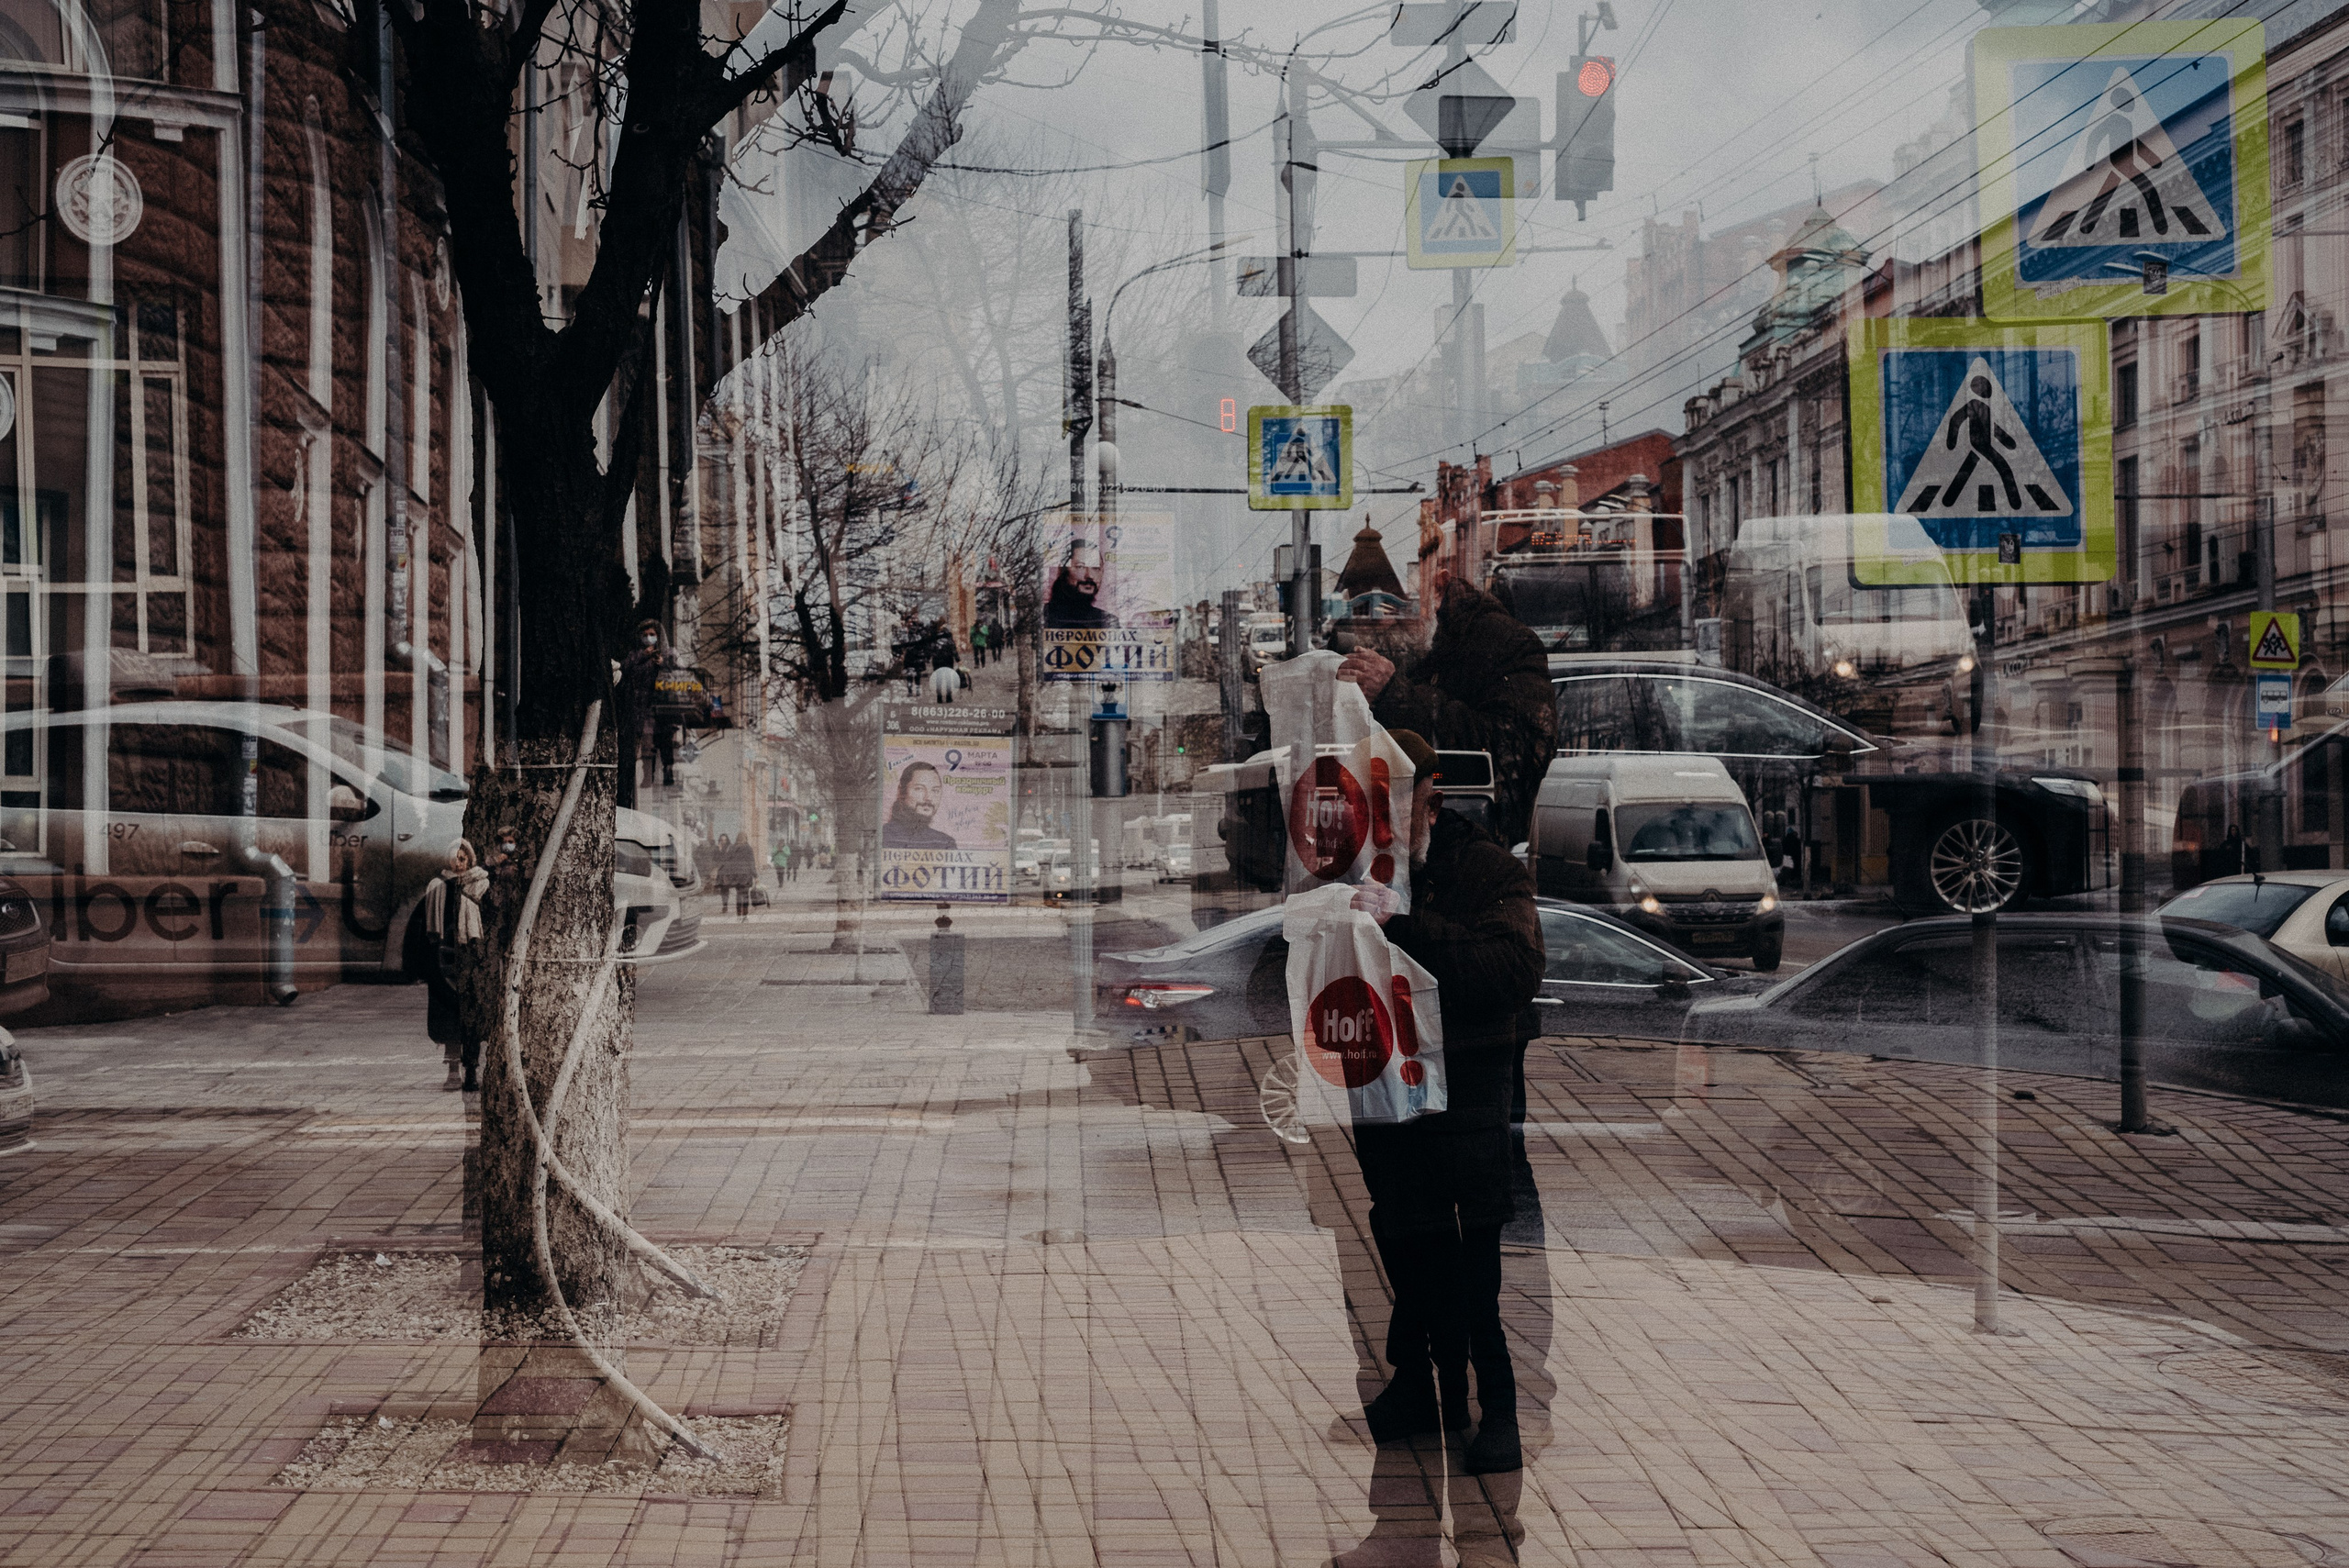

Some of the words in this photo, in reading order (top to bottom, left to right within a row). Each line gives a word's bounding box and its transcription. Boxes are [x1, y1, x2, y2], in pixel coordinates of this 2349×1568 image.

[1105, 525, 1123, 549] 9
[1044, 639, 1168, 670] ФОТИЙ
[911, 706, 1006, 719] 8(863)226-26-00
[944, 749, 963, 772] 9
[967, 751, 998, 760] МАРТА
[882, 862, 1004, 890] ФОТИЙ
[1322, 1007, 1375, 1043] Hoff
